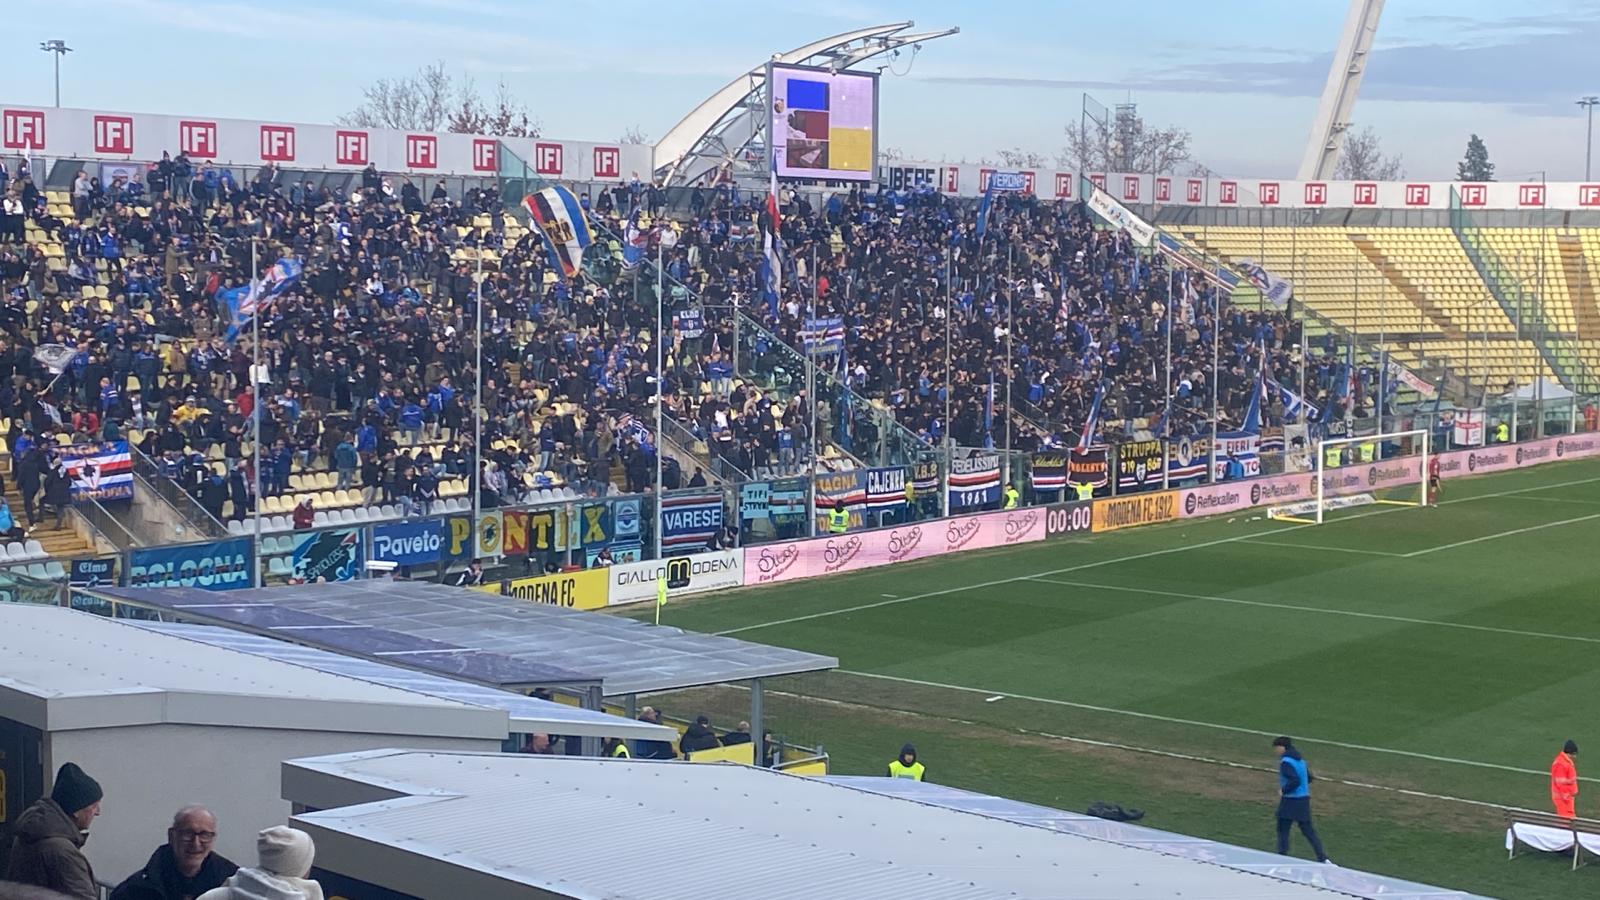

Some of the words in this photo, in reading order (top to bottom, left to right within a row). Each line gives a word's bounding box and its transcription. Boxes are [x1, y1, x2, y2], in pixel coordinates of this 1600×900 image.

[5, 113, 43, 146] IFI
[96, 120, 131, 150] IFI
[181, 124, 215, 153] IFI
[262, 129, 294, 158] IFI
[337, 135, 367, 161] IFI
[408, 139, 436, 165] IFI
[475, 143, 496, 167] IF
[537, 147, 561, 171] IFI
[595, 151, 618, 174] IFI
[1056, 176, 1071, 195] IFI
[1124, 179, 1139, 197] IFI
[1157, 180, 1170, 199] IFI
[1188, 182, 1201, 200] IFI
[1221, 183, 1236, 199] IFI
[1261, 185, 1278, 202] IFI
[1306, 185, 1326, 202] IFI
[1355, 186, 1376, 203] IFI
[1407, 186, 1429, 203] IFI
[1462, 187, 1486, 203] IFI
[1520, 187, 1544, 203] IFI
[1581, 187, 1600, 204] IF
[1121, 439, 1162, 458] STRUPPA
[951, 455, 1000, 474] FEDELISSIMI
[960, 490, 988, 506] 1961
[1197, 491, 1240, 509] Reflexallen
[1261, 483, 1300, 498] Reflexallen
[665, 509, 721, 530] VARESE
[1048, 507, 1090, 533] 00:00
[1107, 499, 1141, 527] MODENA
[1143, 497, 1153, 521] FC
[1156, 495, 1173, 520] 1912
[375, 530, 440, 558] Paveto
[131, 554, 248, 587] BOLOGNA
[508, 581, 557, 606] MODENA
[561, 578, 575, 607] FC
